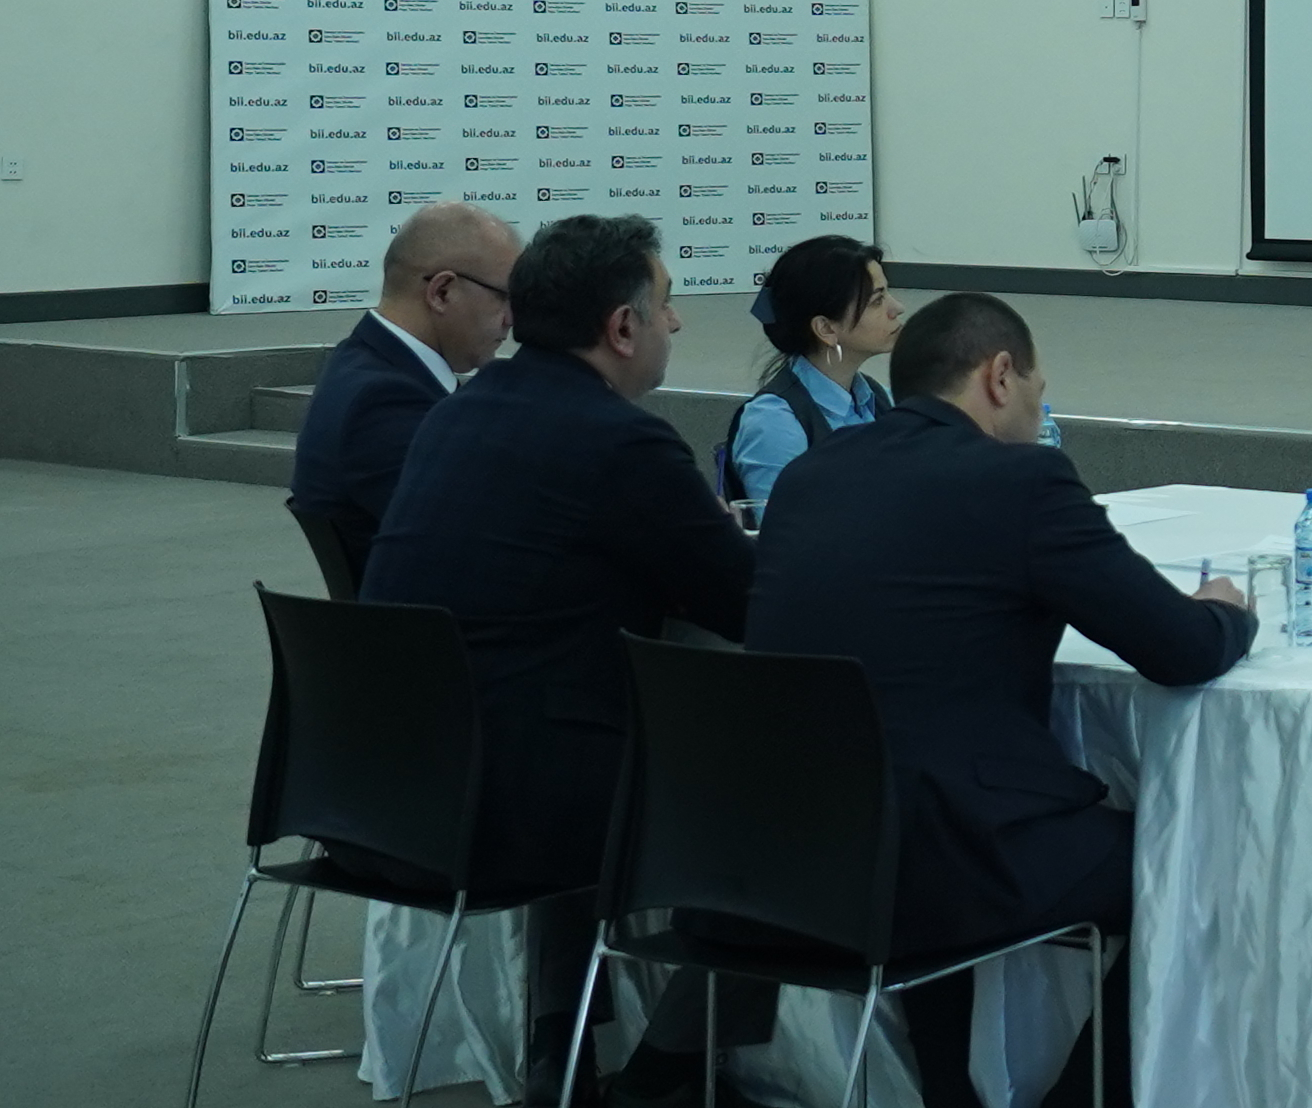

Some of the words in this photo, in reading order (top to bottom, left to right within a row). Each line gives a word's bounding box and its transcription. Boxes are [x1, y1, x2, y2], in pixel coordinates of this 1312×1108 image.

[458, 0, 514, 12] bii.edu.az
[604, 2, 658, 13] bii.edu.az
[743, 3, 794, 14] bii.edu.az
[227, 29, 287, 41] bii.edu.az
[386, 31, 442, 43] bii.edu.az
[535, 32, 590, 44] bii.edu.az
[679, 32, 731, 44] bii.edu.az
[816, 33, 865, 44] bii.edu.az
[308, 62, 366, 74] bii.edu.az
[460, 63, 516, 75] bii.edu.az
[606, 64, 659, 75] bii.edu.az
[745, 63, 795, 74] bii.edu.az
[228, 96, 288, 108] bii.edu.az
[387, 95, 444, 107] bii.edu.az
[537, 95, 591, 107] bii.edu.az
[680, 94, 732, 105] bii.edu.az
[817, 92, 867, 103] bii.edu.az
[309, 128, 367, 140] bii.edu.az
[461, 127, 517, 139] bii.edu.az
[607, 126, 660, 137] bii.edu.az
[746, 124, 797, 135] bii.edu.az
[538, 157, 592, 169] bii.edu.az
[681, 154, 733, 166] bii.edu.az
[818, 152, 868, 162] bii.edu.az
[229, 161, 289, 173] bii.edu.az
[388, 159, 445, 171] bii.edu.az
[608, 187, 661, 198] bii.edu.az
[747, 184, 798, 195] bii.edu.az
[310, 193, 369, 205] bii.edu.az
[463, 190, 518, 202] bii.edu.az
[682, 215, 734, 227] bii.edu.az
[819, 210, 869, 222] bii.edu.az
[230, 227, 291, 239] bii.edu.az
[748, 244, 788, 256] bii.edu.
[311, 258, 370, 270] bii.edu.az
[683, 276, 735, 287] bii.edu.az
[232, 293, 292, 305] bii.edu.az
